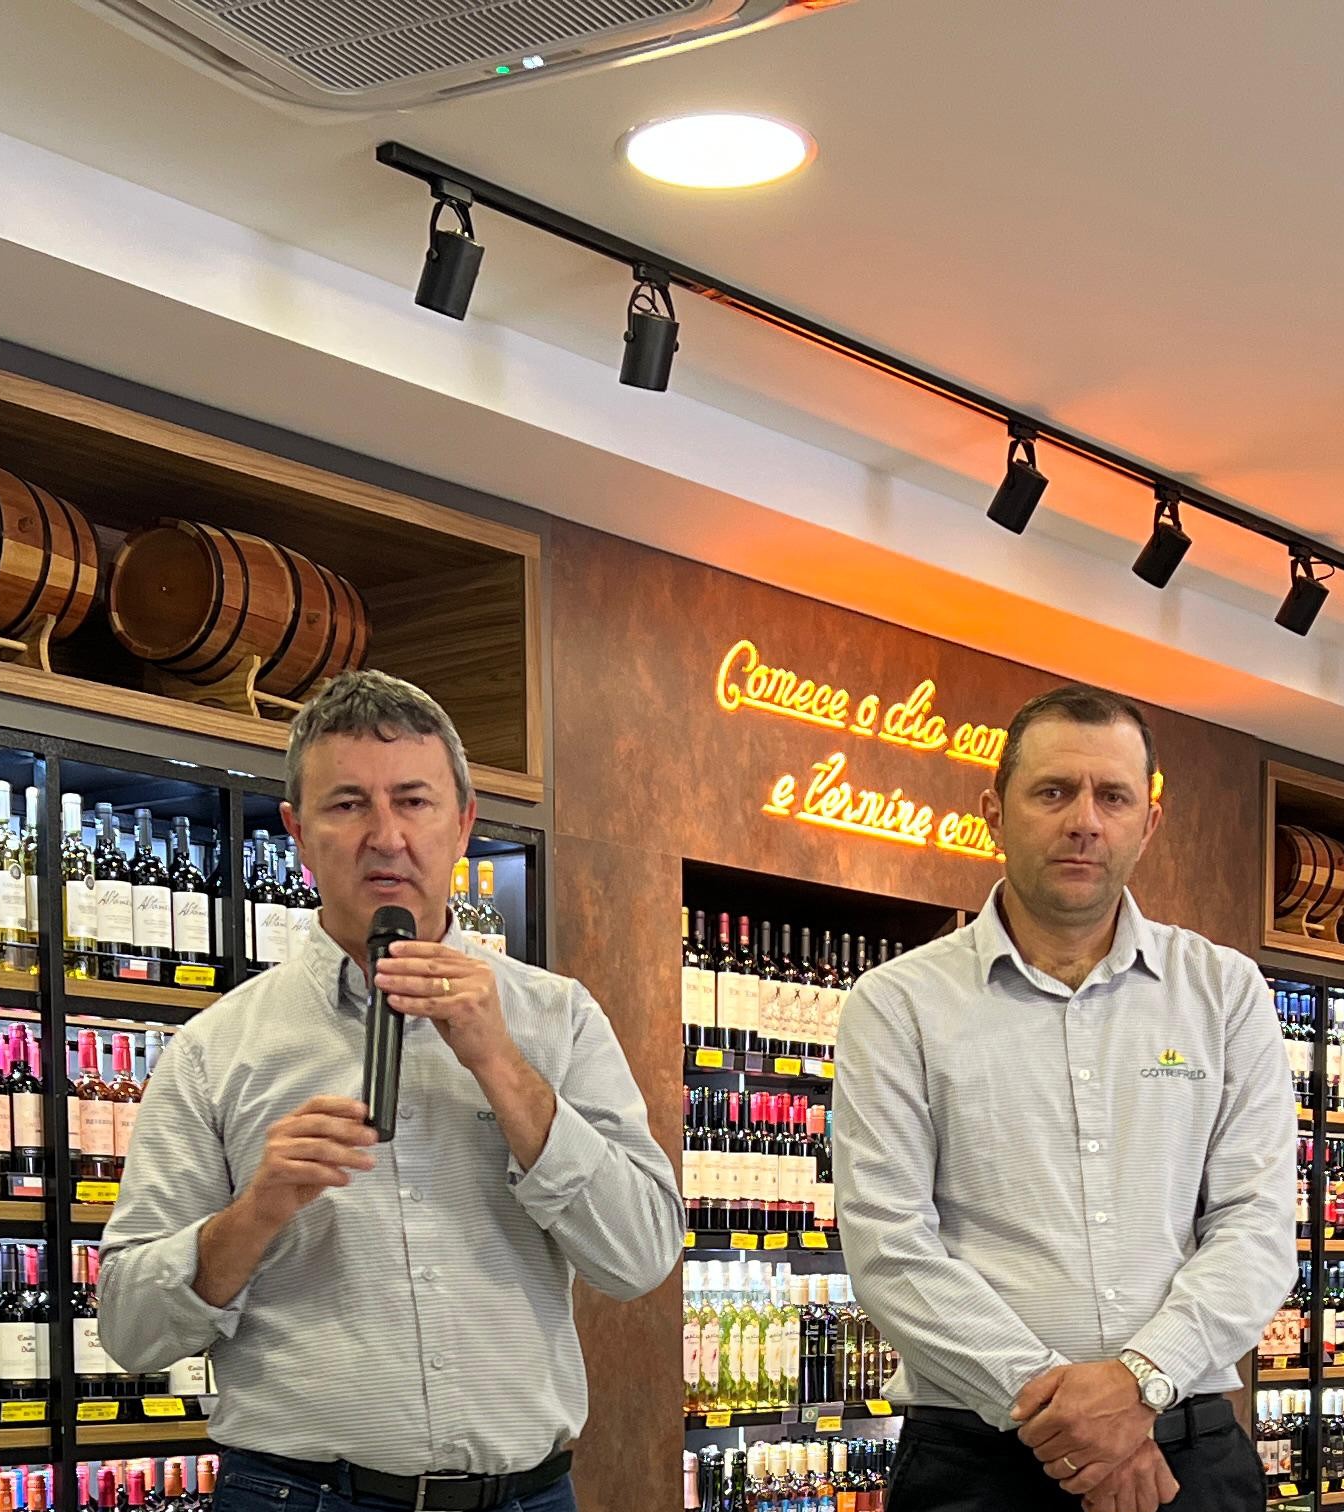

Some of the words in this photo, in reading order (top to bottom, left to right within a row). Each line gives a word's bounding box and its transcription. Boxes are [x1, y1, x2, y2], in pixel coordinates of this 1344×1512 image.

[717, 640, 849, 720] Comece
[855, 694, 879, 733] o
[882, 680, 948, 748] dia
[773, 774, 797, 809] e
[1140, 1068, 1206, 1080] COTRIFRED
